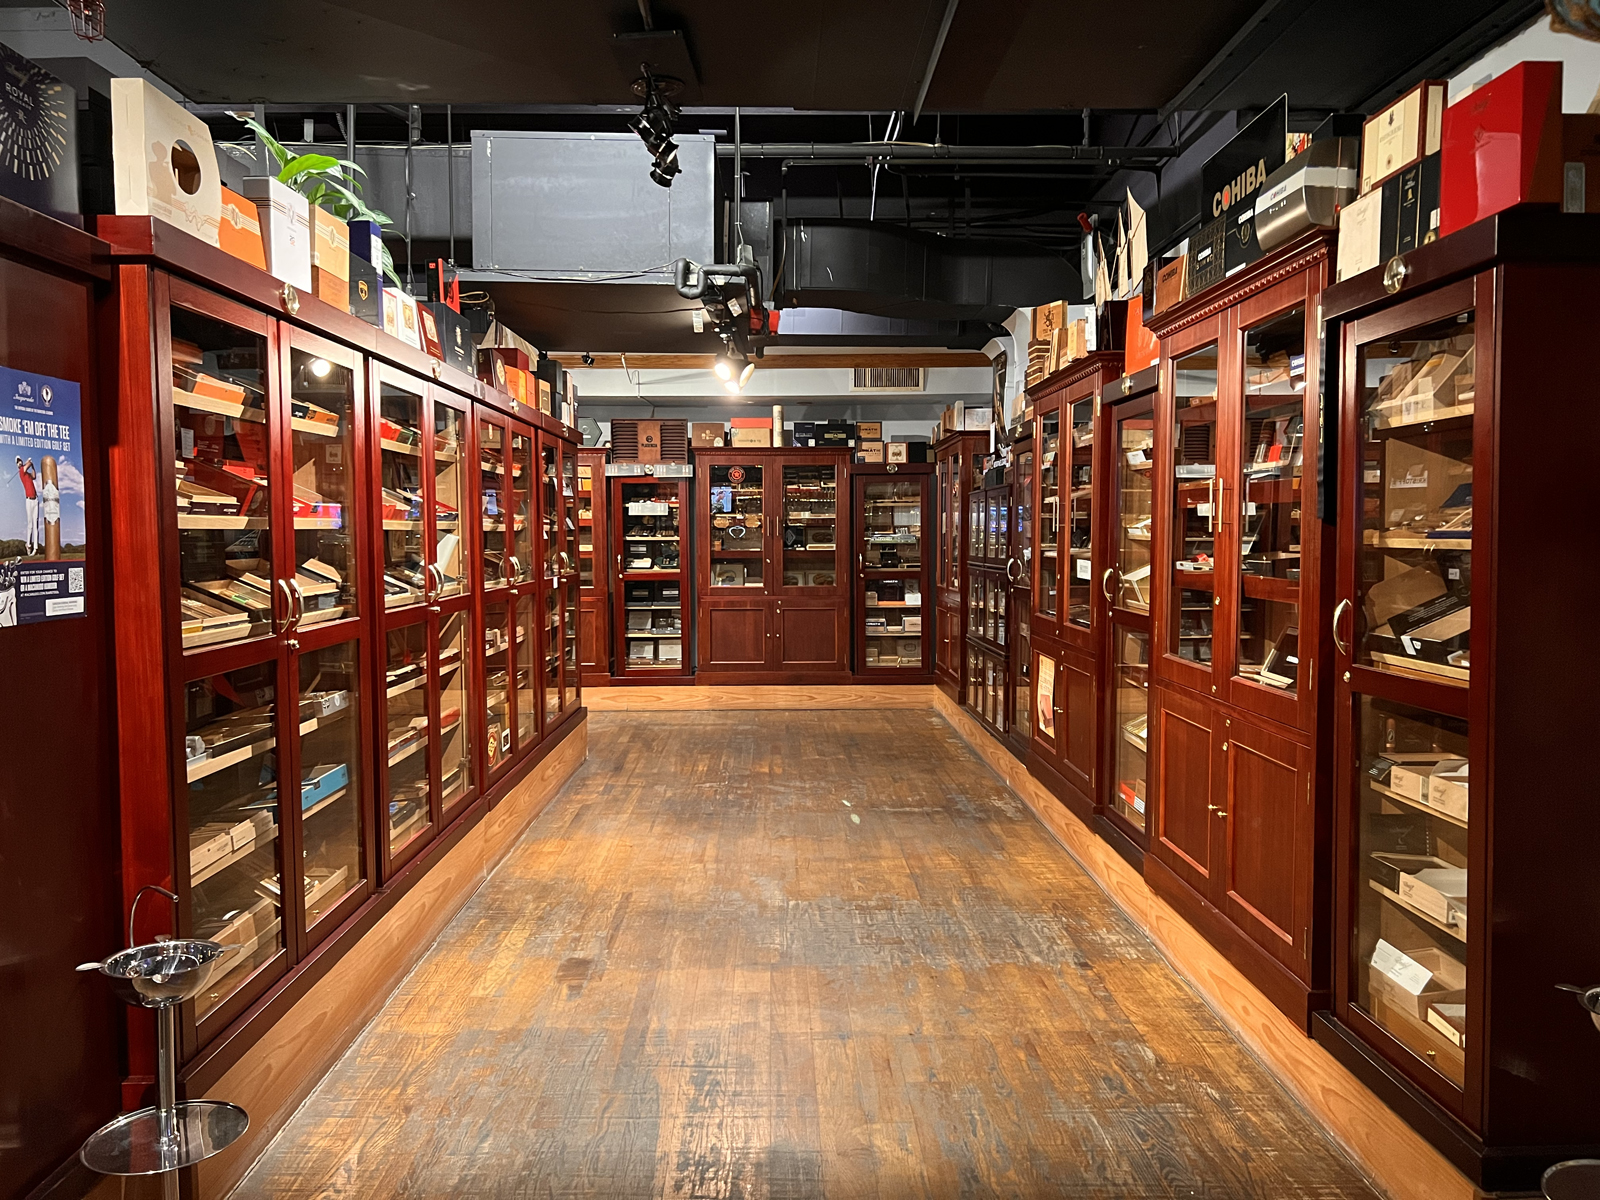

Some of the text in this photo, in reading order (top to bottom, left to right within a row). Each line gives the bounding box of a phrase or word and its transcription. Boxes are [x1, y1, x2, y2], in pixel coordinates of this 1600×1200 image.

[5, 82, 34, 106] ROYAL
[1213, 158, 1267, 218] COHIBA
[0, 416, 21, 433] SMOKE
[35, 421, 46, 437] OFF
[47, 423, 59, 438] THE
[59, 425, 70, 440] TEE
[15, 436, 33, 447] LIMITED
[34, 438, 51, 450] EDITION
[52, 440, 62, 451] GOLF
[63, 442, 71, 452] SET
